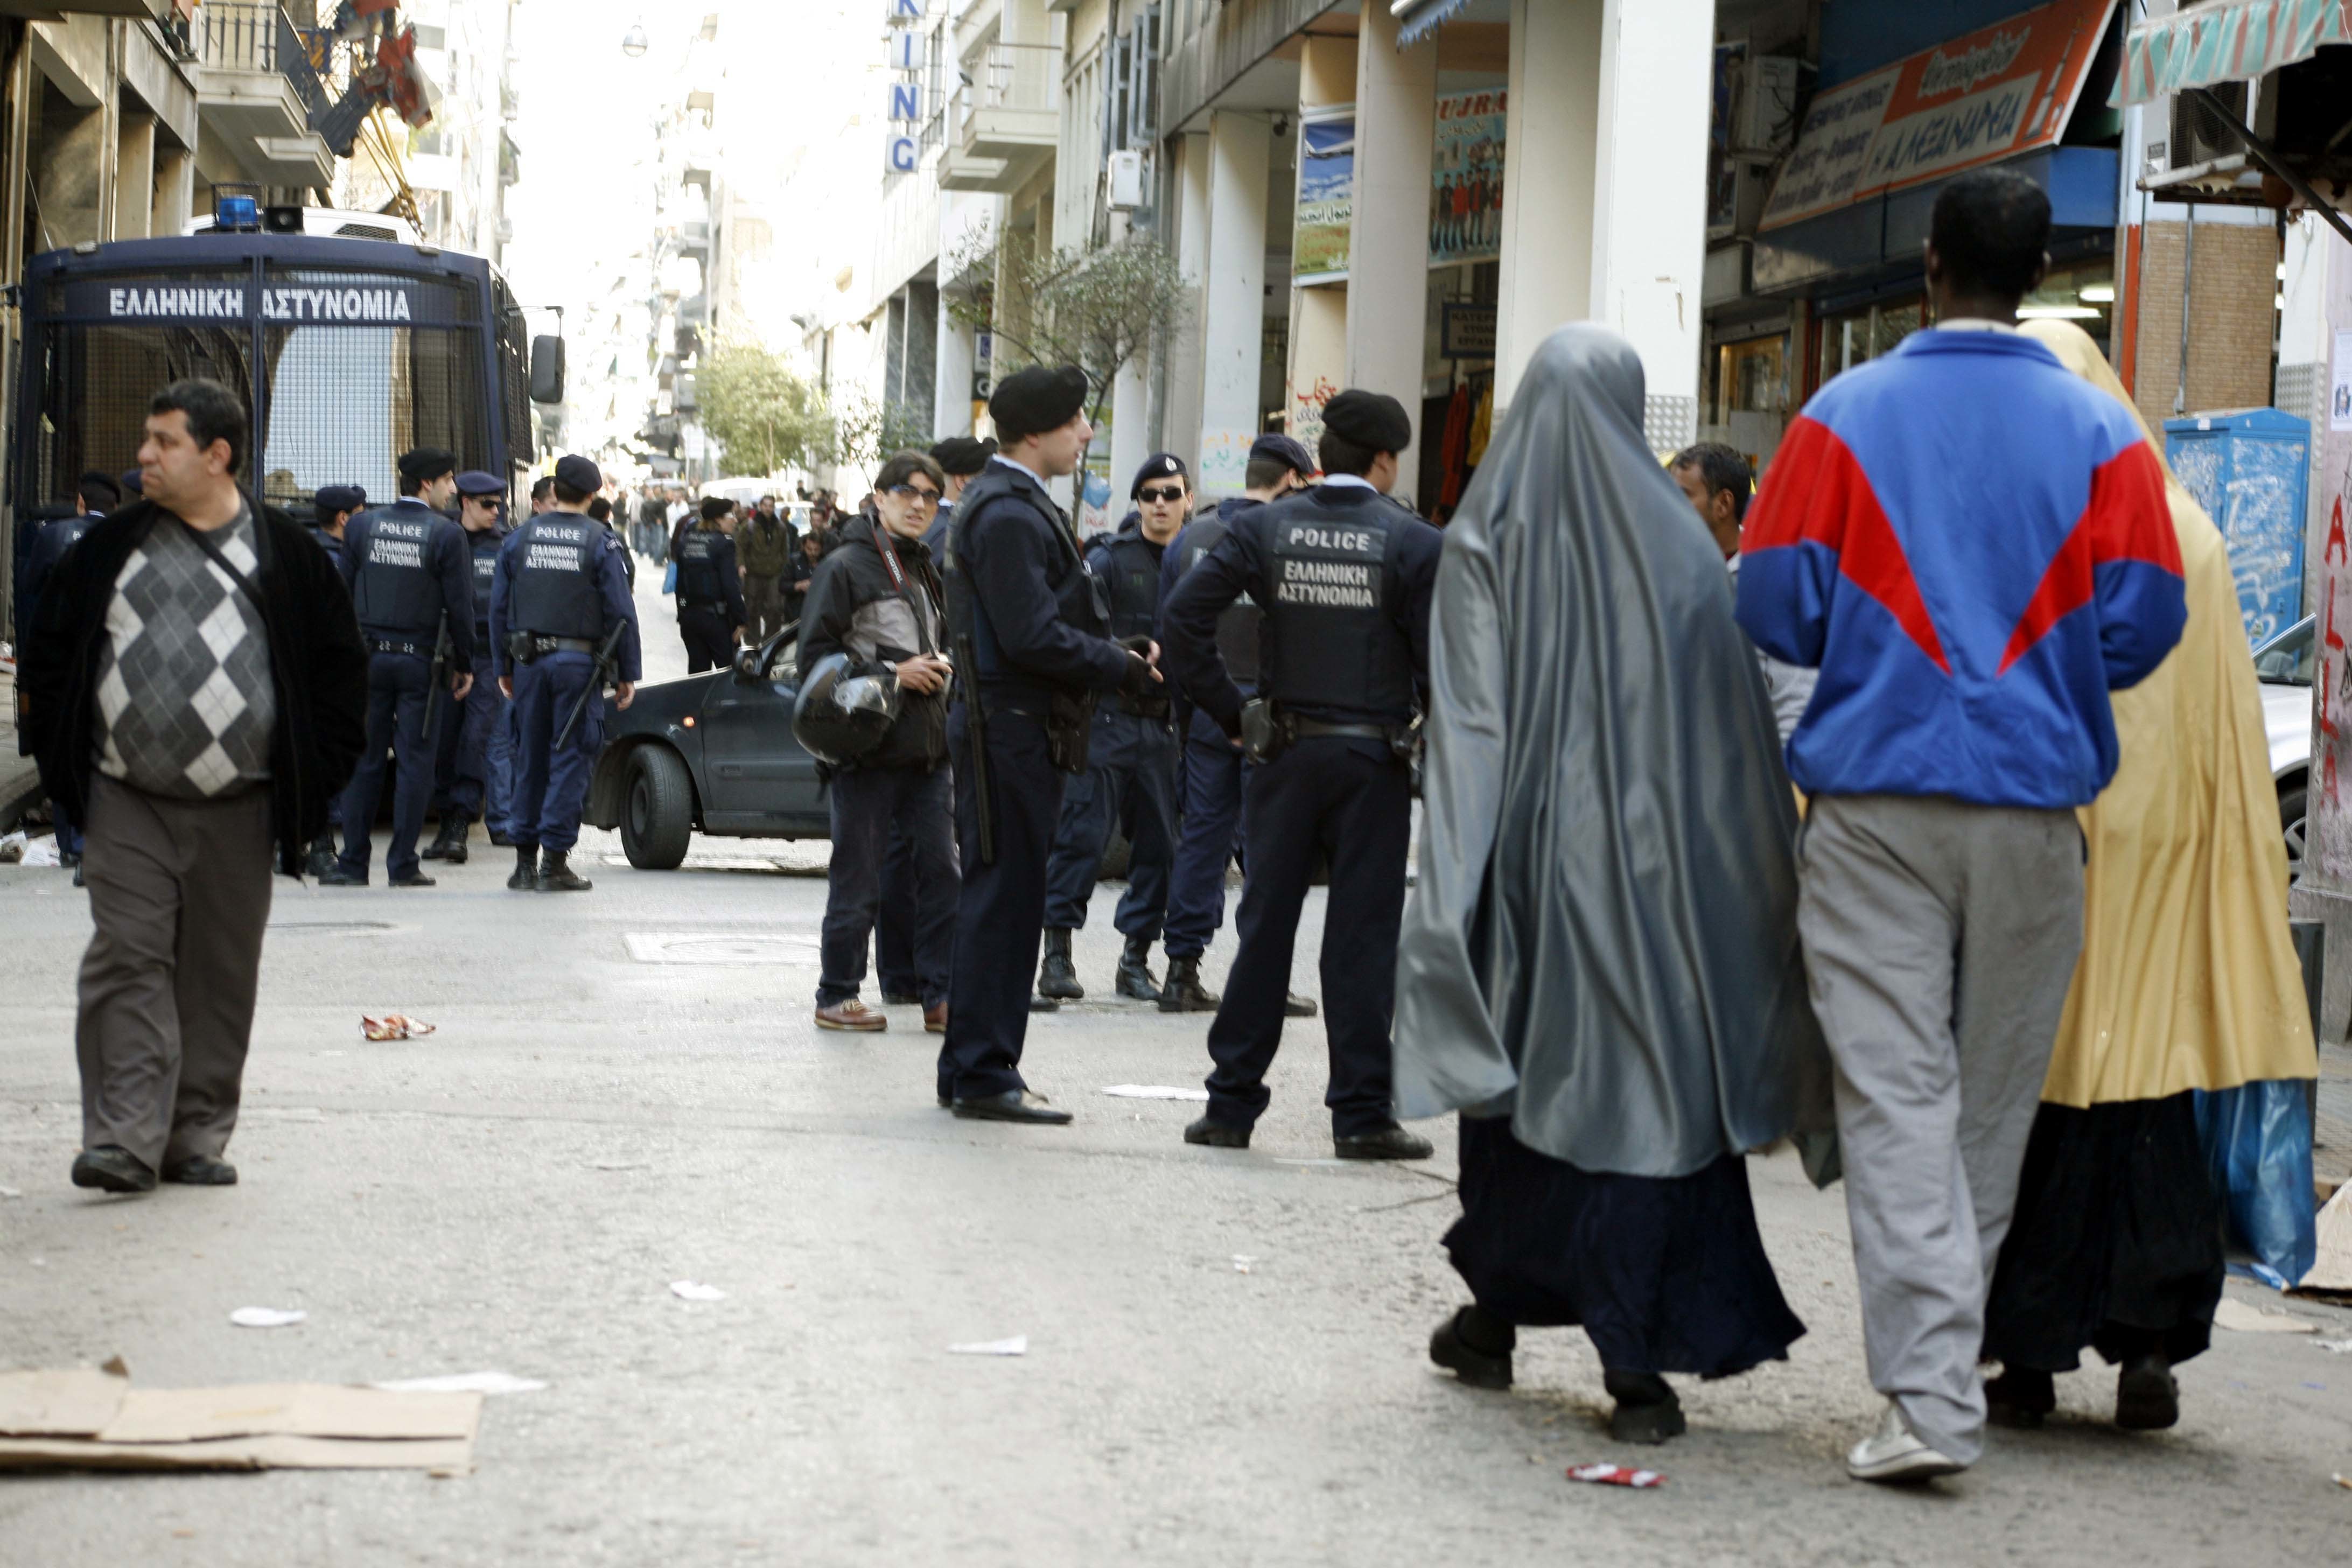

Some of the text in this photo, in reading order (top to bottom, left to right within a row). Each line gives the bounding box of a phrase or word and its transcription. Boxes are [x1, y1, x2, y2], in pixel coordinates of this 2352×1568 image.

[109, 288, 411, 321] ΕΛΛΗΝΙΚΗ ΑΣΤΥΝΟΜΙΑ
[379, 521, 422, 537] POLICE
[536, 527, 581, 541] POLICE
[1289, 527, 1370, 552] POLICE
[1284, 560, 1369, 585] ΕΛΛΗΝΙΚΗ
[1277, 582, 1374, 607] ΑΣΤΥΝΟΜΙΑ
